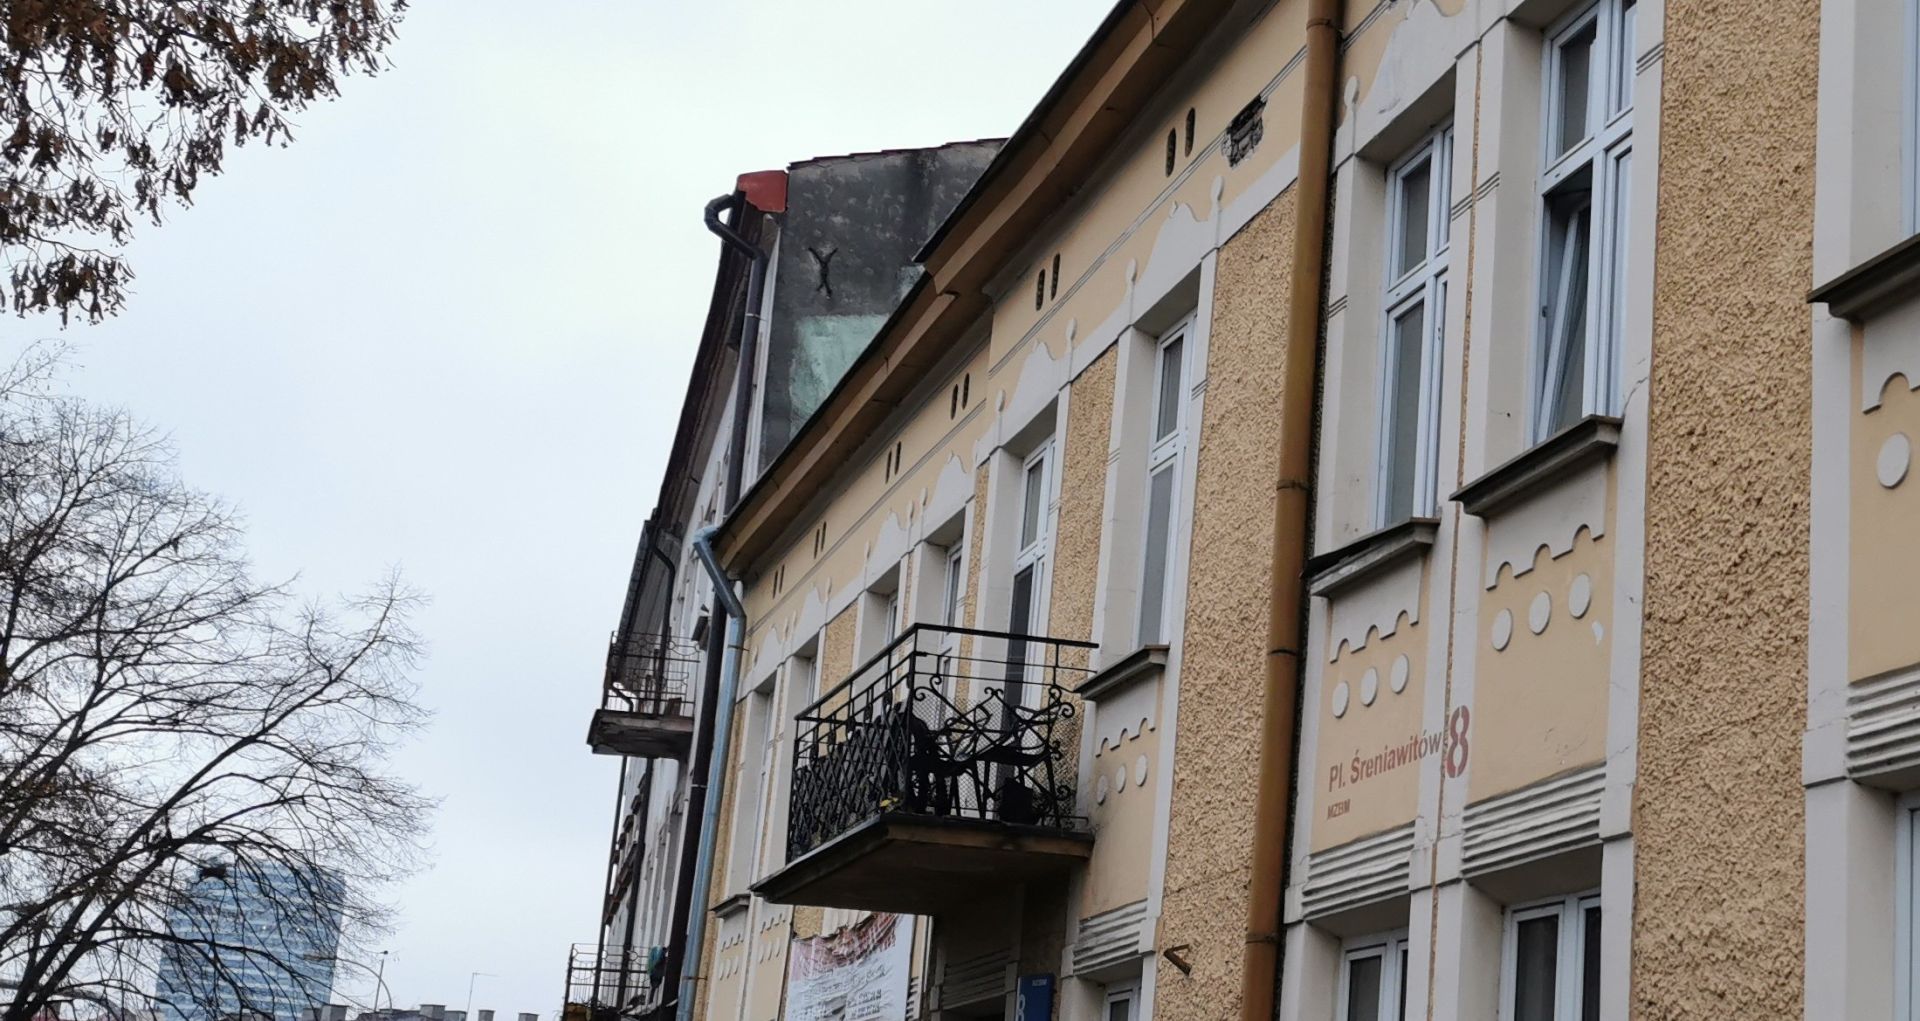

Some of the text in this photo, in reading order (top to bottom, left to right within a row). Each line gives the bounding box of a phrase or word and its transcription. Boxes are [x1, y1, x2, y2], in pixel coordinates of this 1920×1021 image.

[1329, 705, 1470, 792] Pl. Śreniawitów 8
